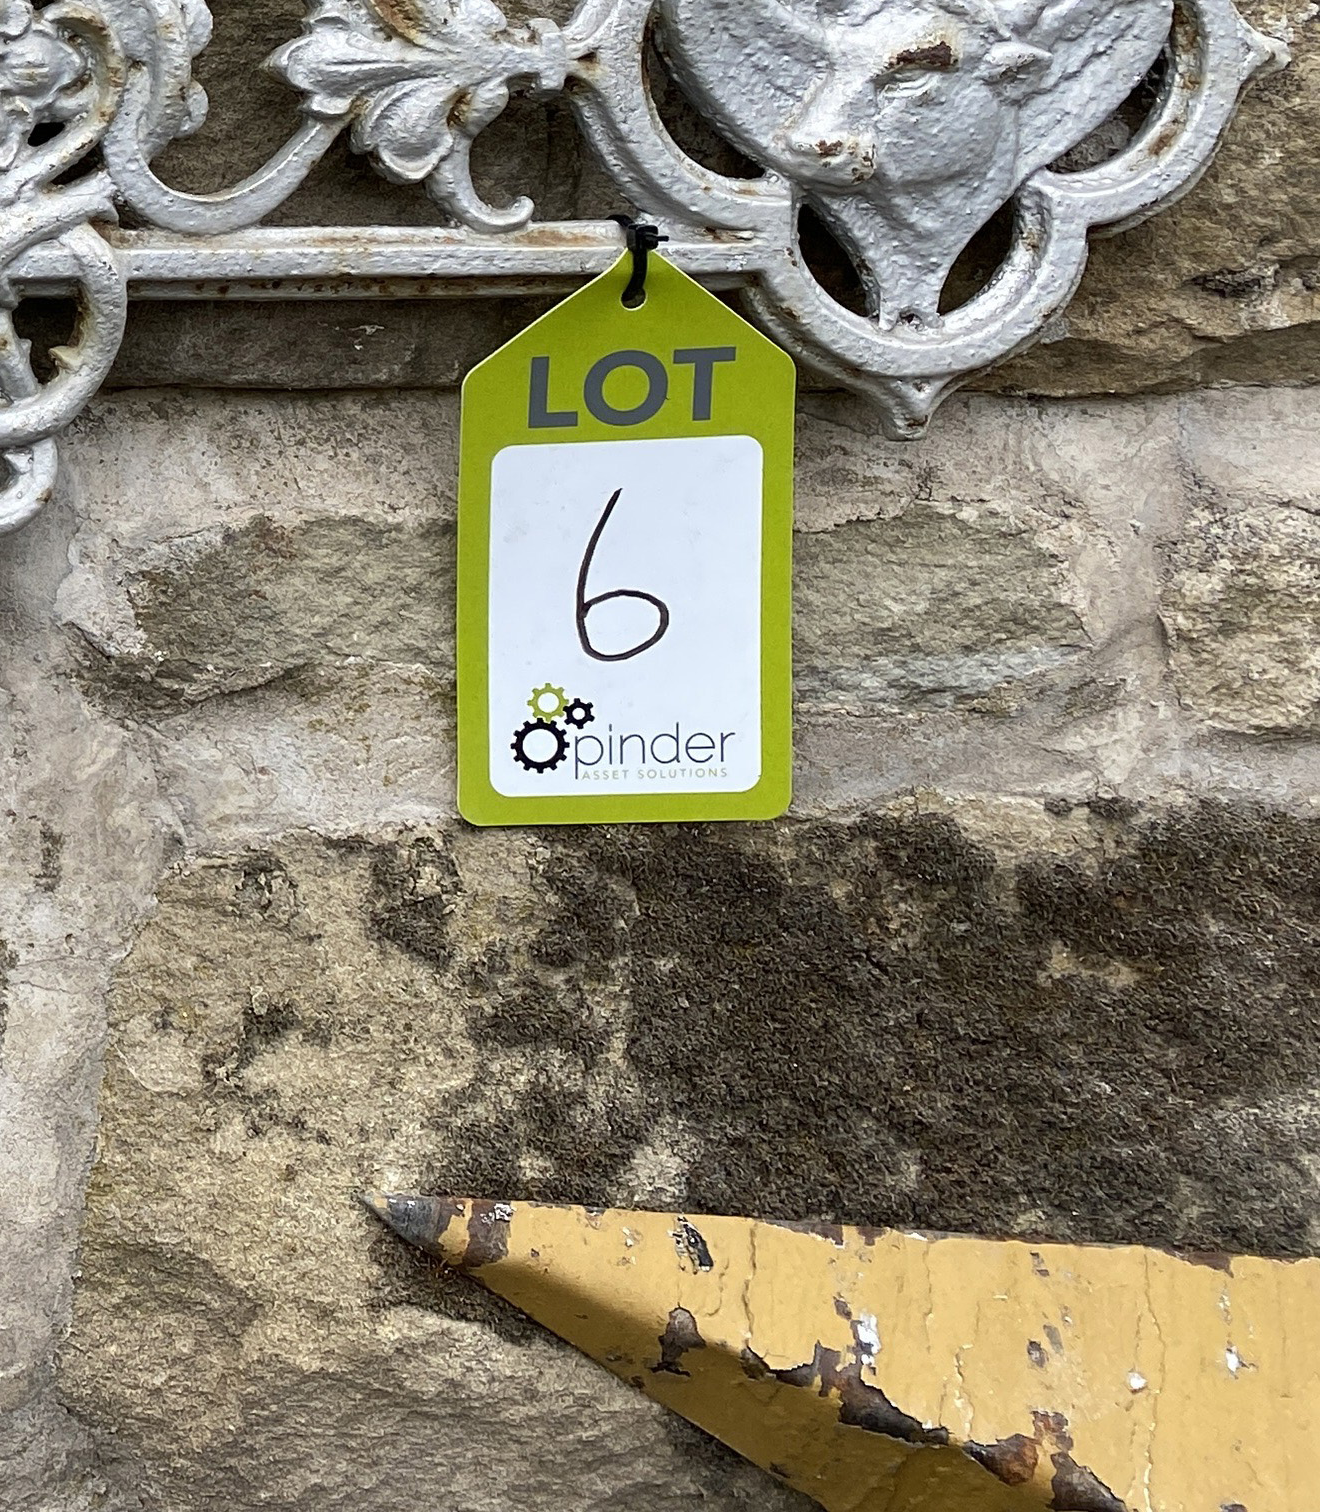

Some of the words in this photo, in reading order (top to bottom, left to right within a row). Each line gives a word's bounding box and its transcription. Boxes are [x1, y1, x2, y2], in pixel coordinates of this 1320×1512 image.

[527, 346, 736, 429] LOT
[576, 487, 670, 662] 6
[574, 721, 736, 780] pinder
[583, 770, 628, 780] ASSET
[638, 768, 727, 779] SOLUTIONS
